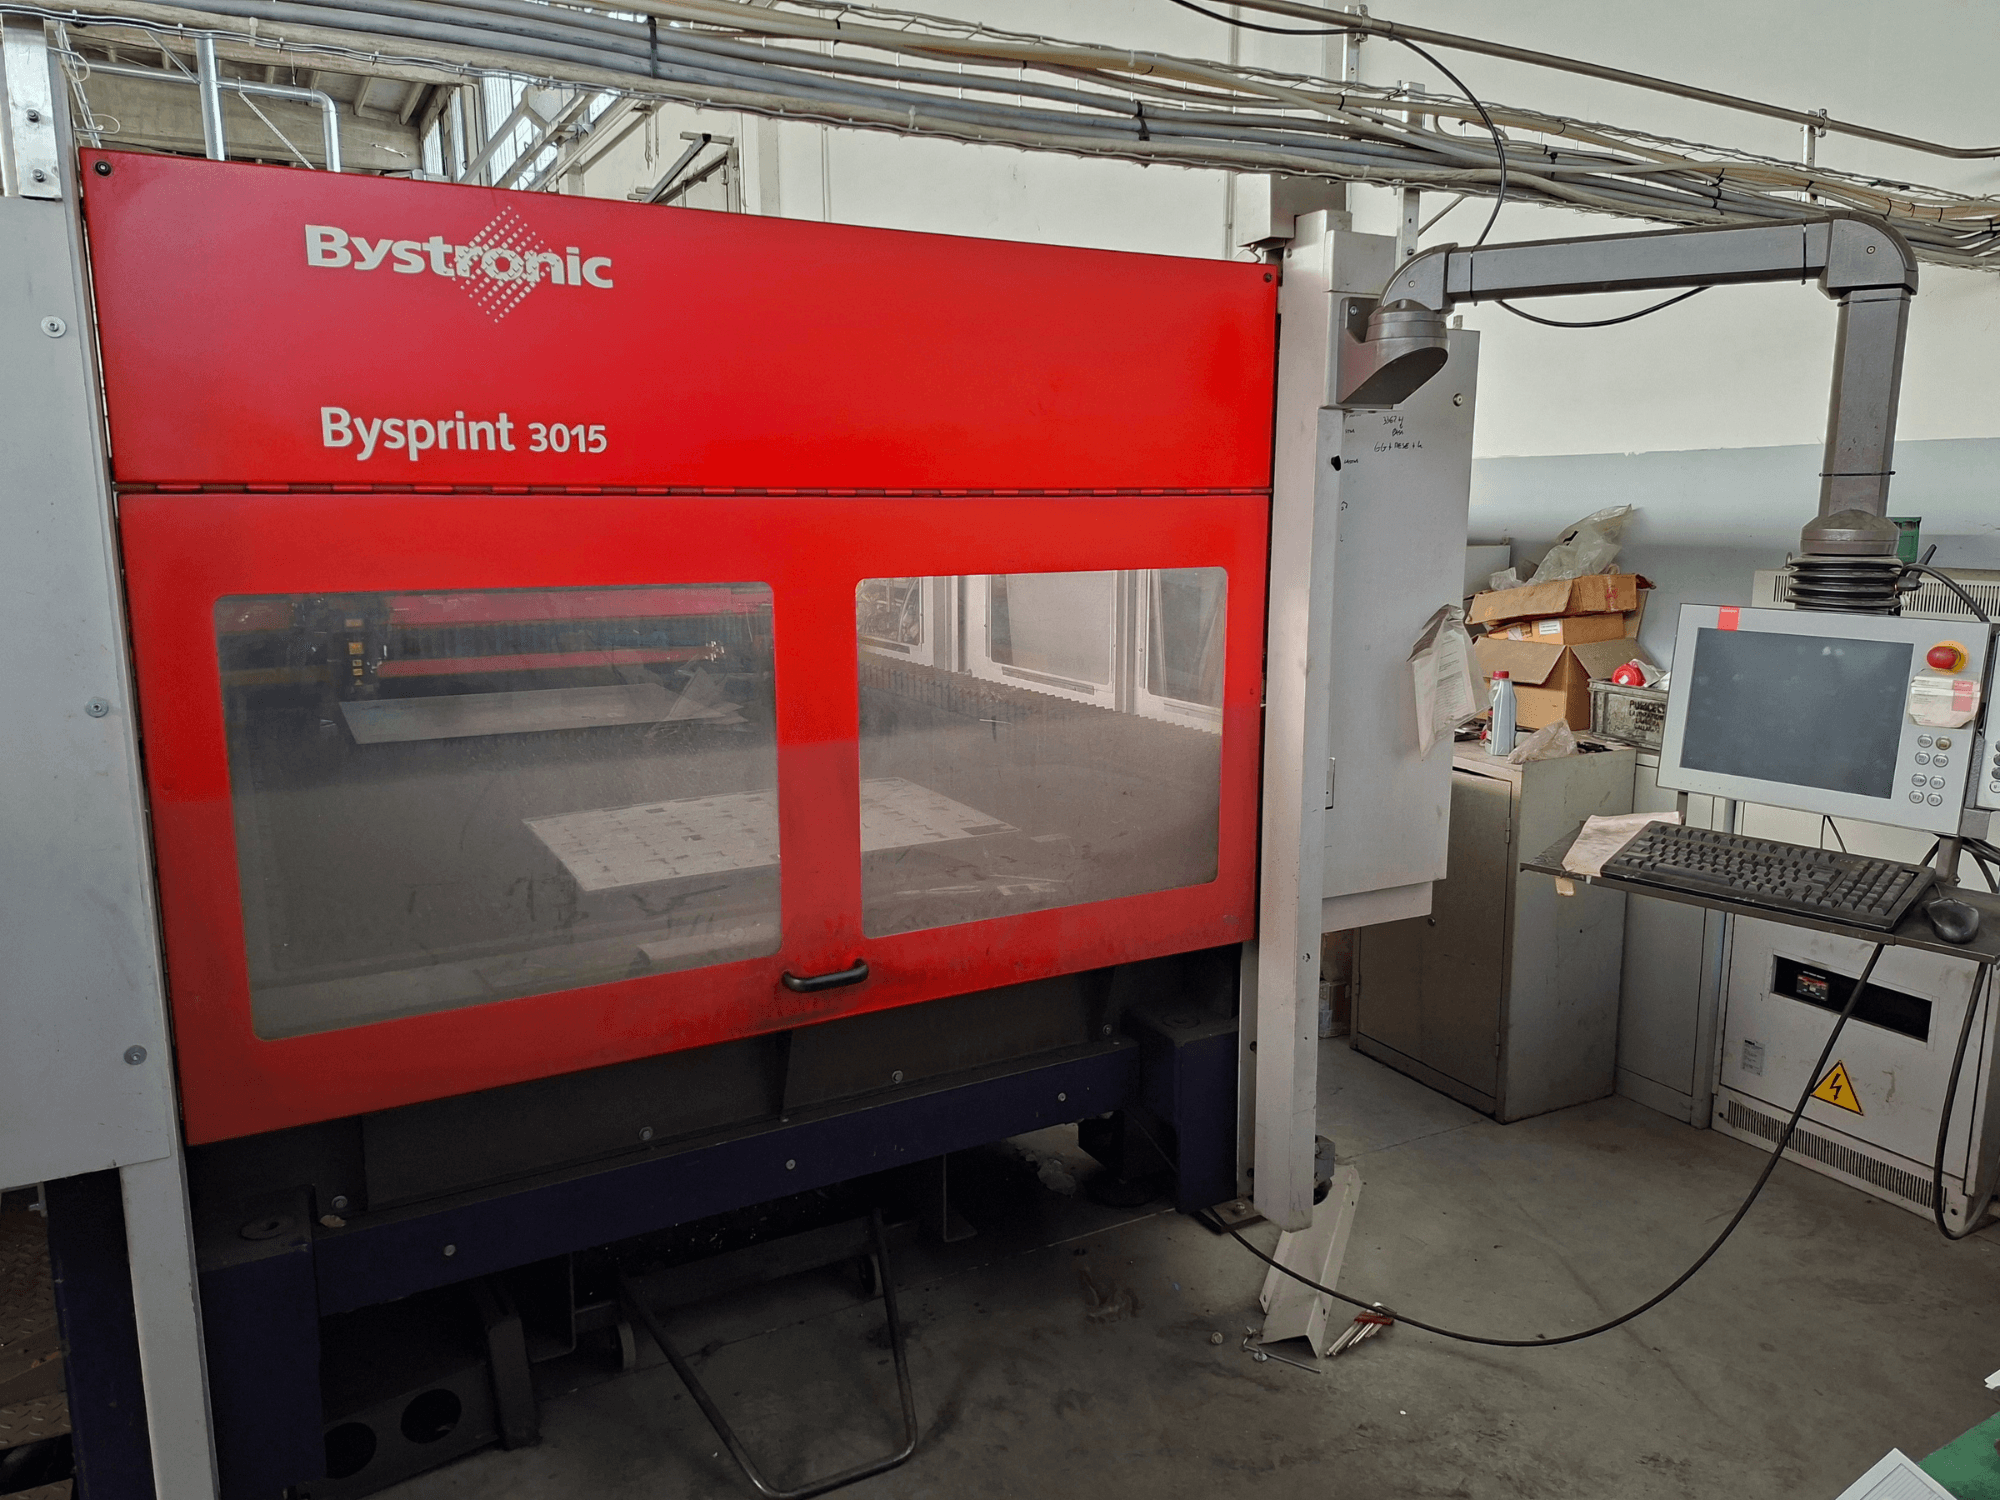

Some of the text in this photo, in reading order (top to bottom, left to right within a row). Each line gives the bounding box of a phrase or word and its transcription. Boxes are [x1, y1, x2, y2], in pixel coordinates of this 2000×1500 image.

[305, 224, 614, 289] Bystronic
[321, 406, 608, 462] Bysprint 3015
